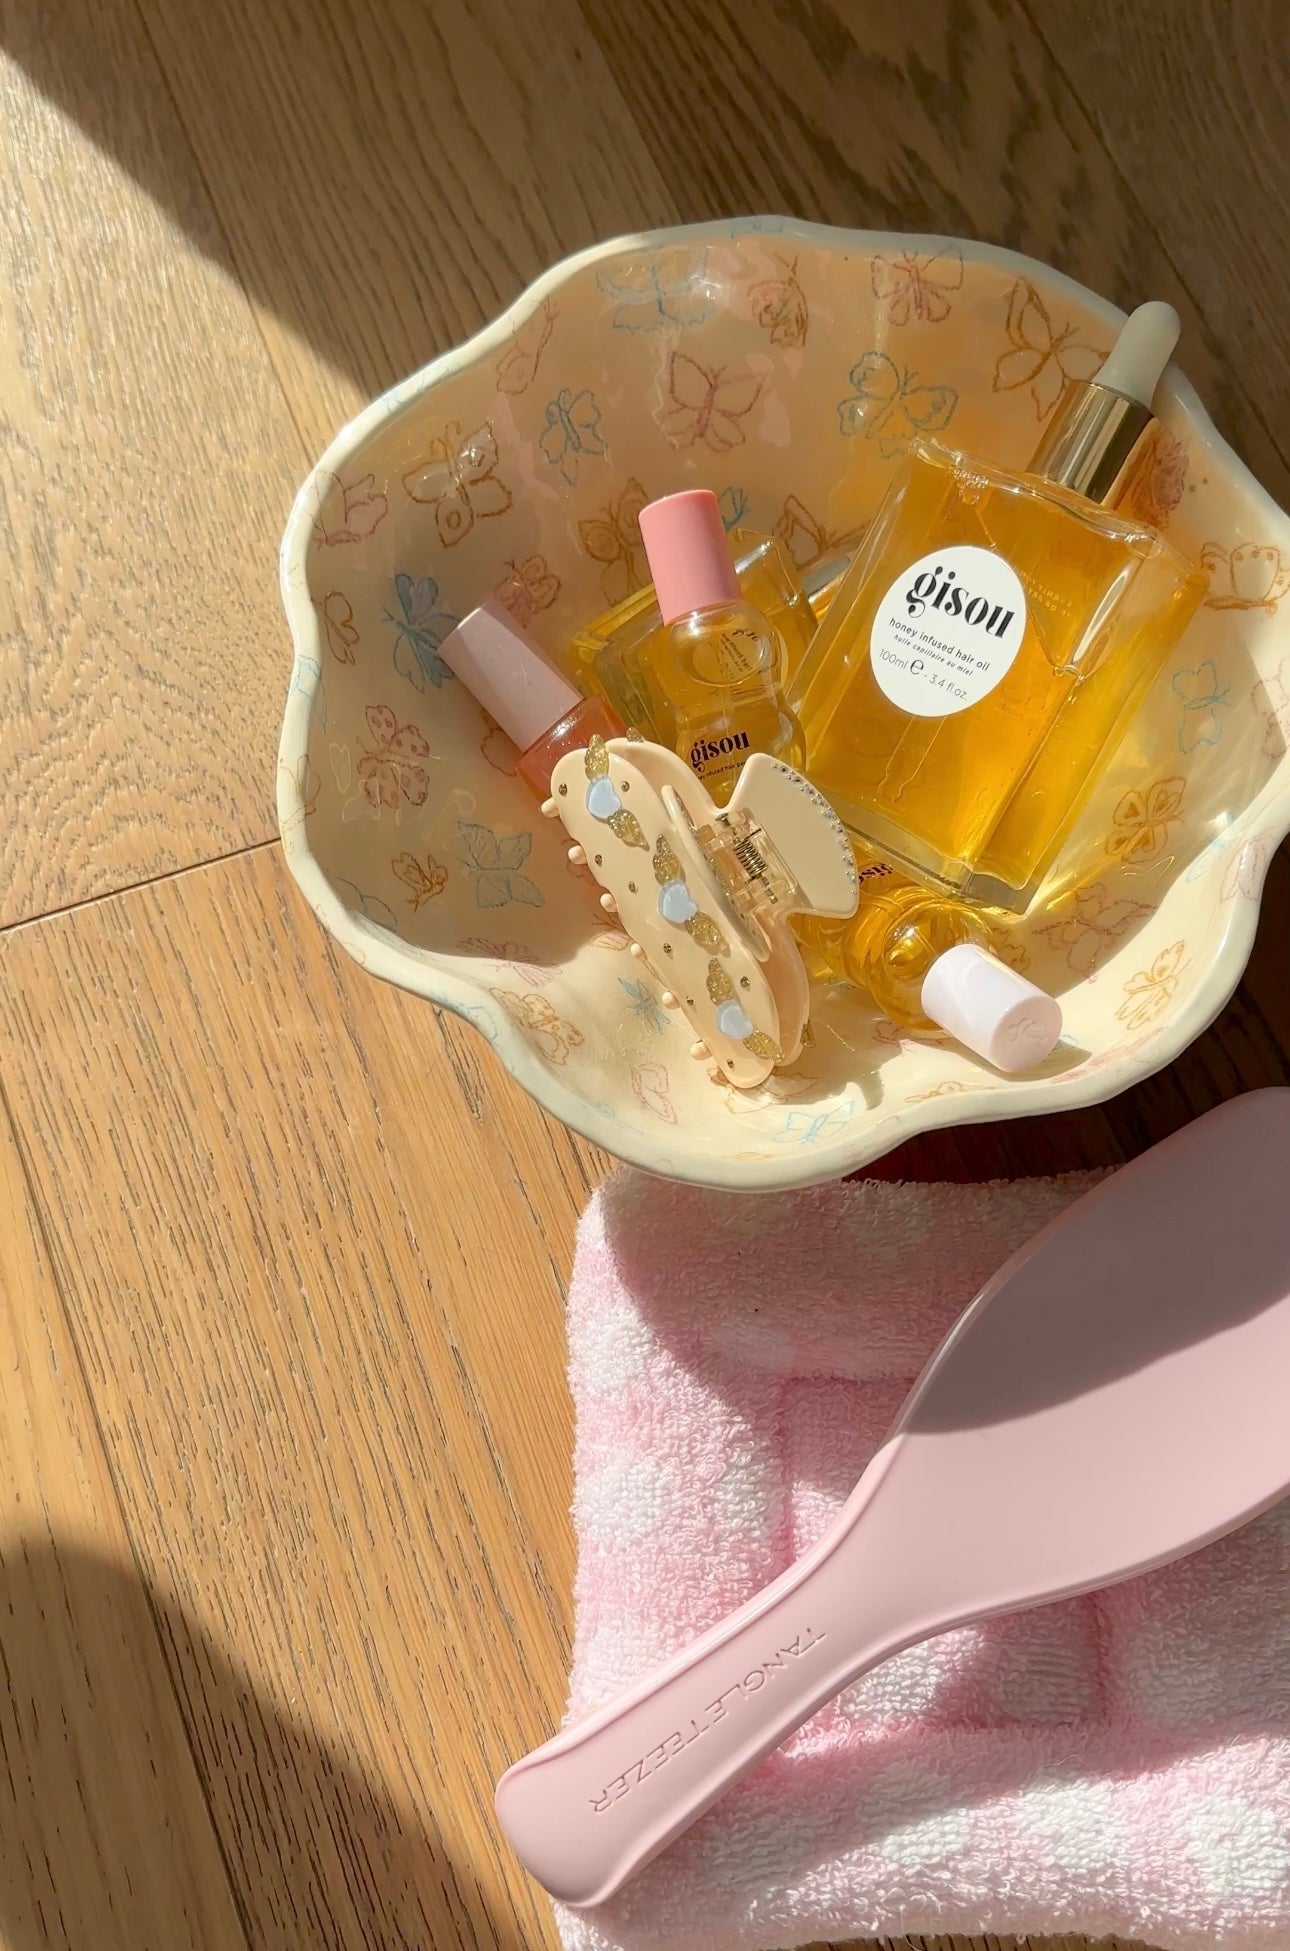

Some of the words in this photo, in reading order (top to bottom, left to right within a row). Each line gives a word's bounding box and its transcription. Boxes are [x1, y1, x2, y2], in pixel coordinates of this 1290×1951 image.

[906, 566, 1015, 639] gisou
[889, 617, 918, 638] honey
[919, 631, 955, 654] infused
[955, 650, 975, 665] hair
[976, 660, 990, 672] oil
[893, 633, 911, 646] huile
[912, 644, 945, 663] capillaire
[946, 660, 956, 669] au
[956, 665, 974, 676] miel
[879, 648, 908, 670] 100ml
[929, 673, 945, 688] 3.4
[691, 732, 749, 772] gisou
